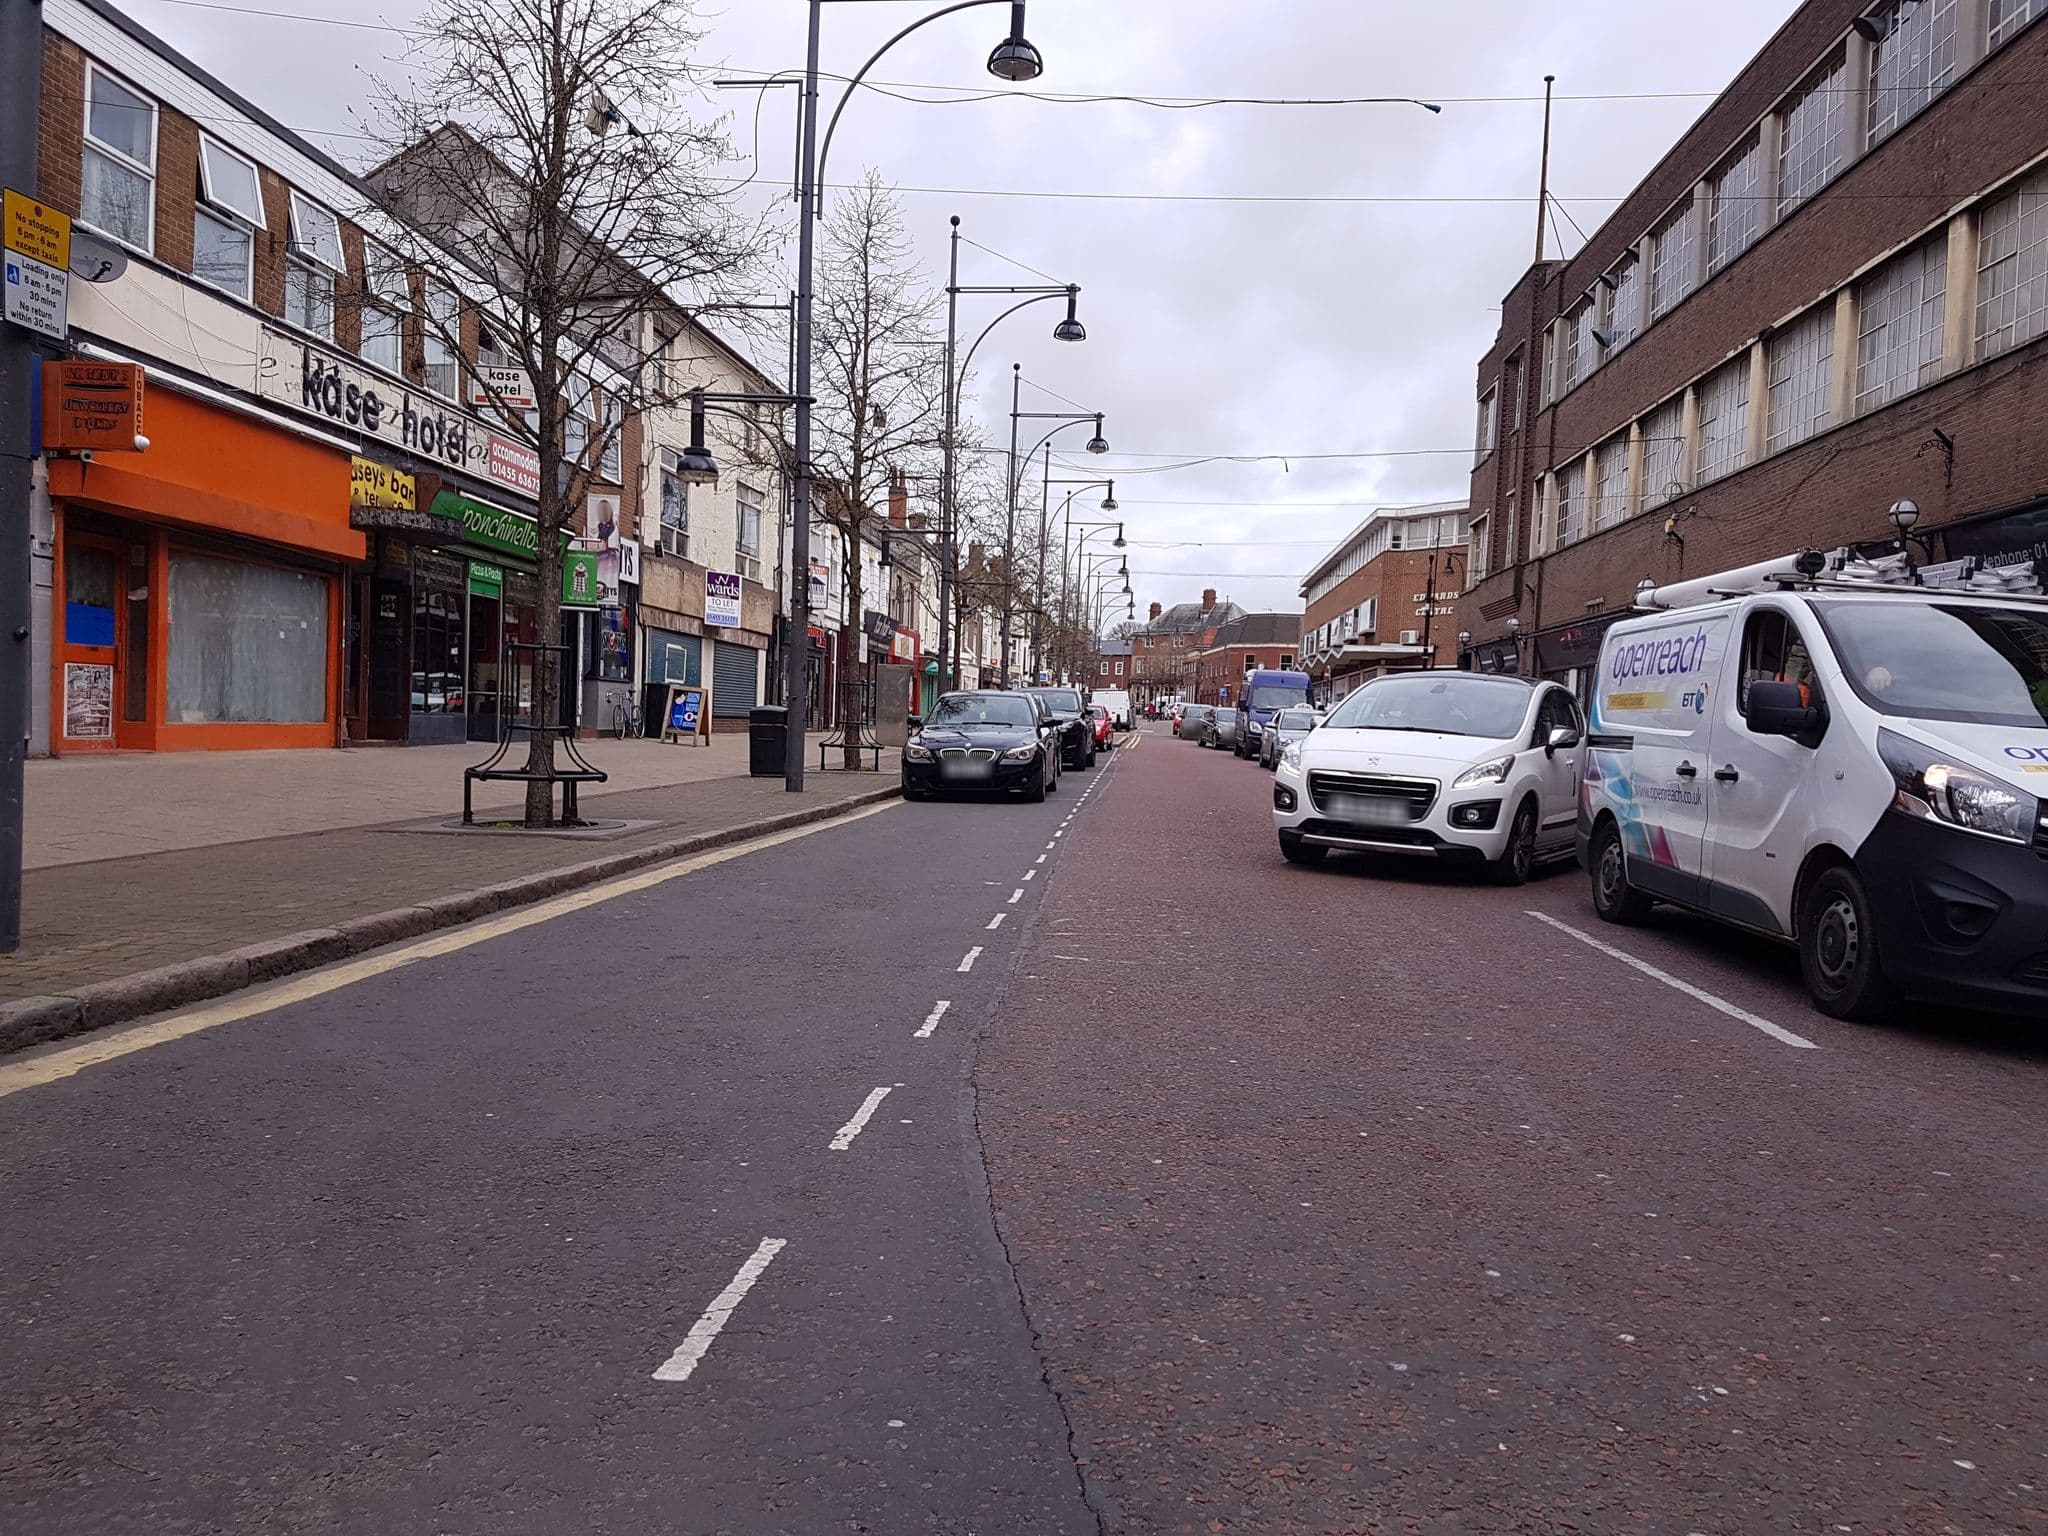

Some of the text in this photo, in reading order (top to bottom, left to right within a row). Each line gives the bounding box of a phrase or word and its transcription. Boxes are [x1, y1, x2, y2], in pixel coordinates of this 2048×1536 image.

[16, 211, 60, 239] No stopping
[17, 226, 23, 235] 6
[24, 231, 35, 241] pm
[40, 236, 45, 245] 6
[46, 240, 57, 249] am
[15, 240, 59, 263] except taxis
[22, 259, 66, 285] Loading only
[24, 275, 29, 284] 6
[30, 279, 41, 288] am
[46, 283, 51, 292] 6
[51, 287, 62, 297] pm
[30, 290, 56, 308] 30 mins
[19, 301, 53, 320] No return
[11, 310, 60, 334] within 30 mins
[488, 367, 520, 381] kase
[402, 391, 467, 467] hotel
[492, 442, 540, 476] accommodati
[391, 471, 414, 500] bar
[492, 461, 540, 492] 01455 63673
[1983, 548, 2034, 568] lephone:
[707, 583, 739, 597] wards
[1413, 591, 1459, 602] EDARDS
[712, 598, 734, 608] TO LET
[1415, 607, 1454, 616] CETRE
[1613, 625, 1707, 687] openreach
[1682, 693, 1696, 707] BT
